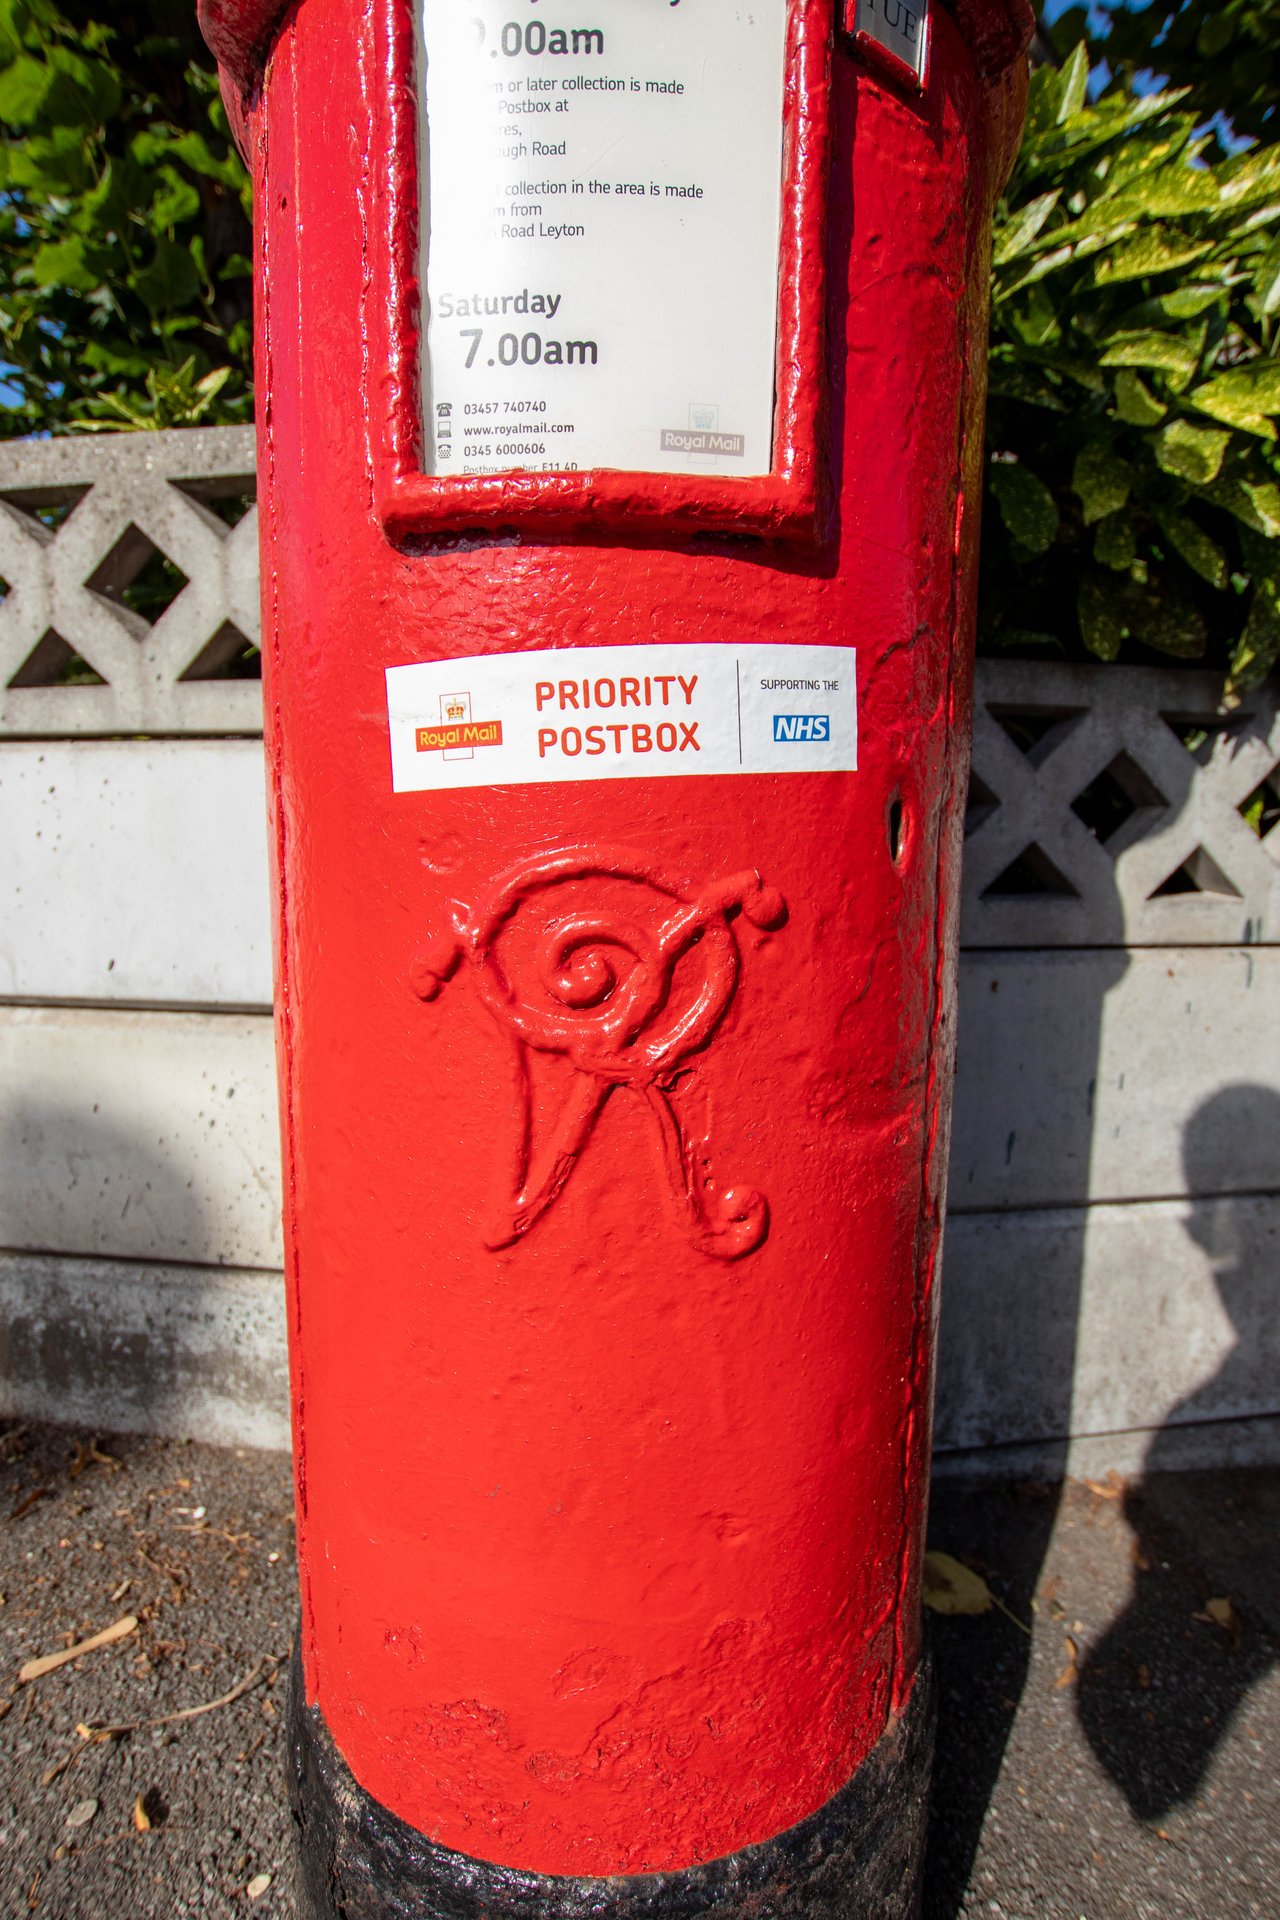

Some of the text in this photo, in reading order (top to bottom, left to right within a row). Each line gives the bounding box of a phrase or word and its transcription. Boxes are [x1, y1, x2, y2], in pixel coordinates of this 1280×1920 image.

[507, 80, 523, 92] or
[526, 77, 558, 91] later
[561, 76, 626, 91] collection
[630, 77, 641, 91] is
[645, 79, 684, 94] made
[498, 99, 570, 114] Postbox at
[532, 141, 566, 156] Road
[504, 180, 567, 196] collection
[571, 180, 584, 194] in
[588, 180, 611, 195] the
[615, 184, 645, 195] area
[649, 181, 661, 196] is
[665, 183, 703, 198] made
[510, 202, 542, 216] from
[501, 223, 535, 238] Road
[539, 222, 585, 240] Leyton
[438, 289, 561, 318] Saturday
[459, 328, 598, 368] 7.00am
[464, 401, 546, 414] 03457 740740
[464, 422, 575, 436] www.royalmail.com
[464, 443, 546, 456] 0345 6000606
[664, 432, 740, 452] Royal Mail
[535, 675, 698, 712] PRIORITY
[760, 679, 839, 691] SUPPORTING THE
[420, 725, 497, 747] Royal Mail
[775, 716, 828, 740] NHS
[538, 721, 700, 758] POSTBOX
